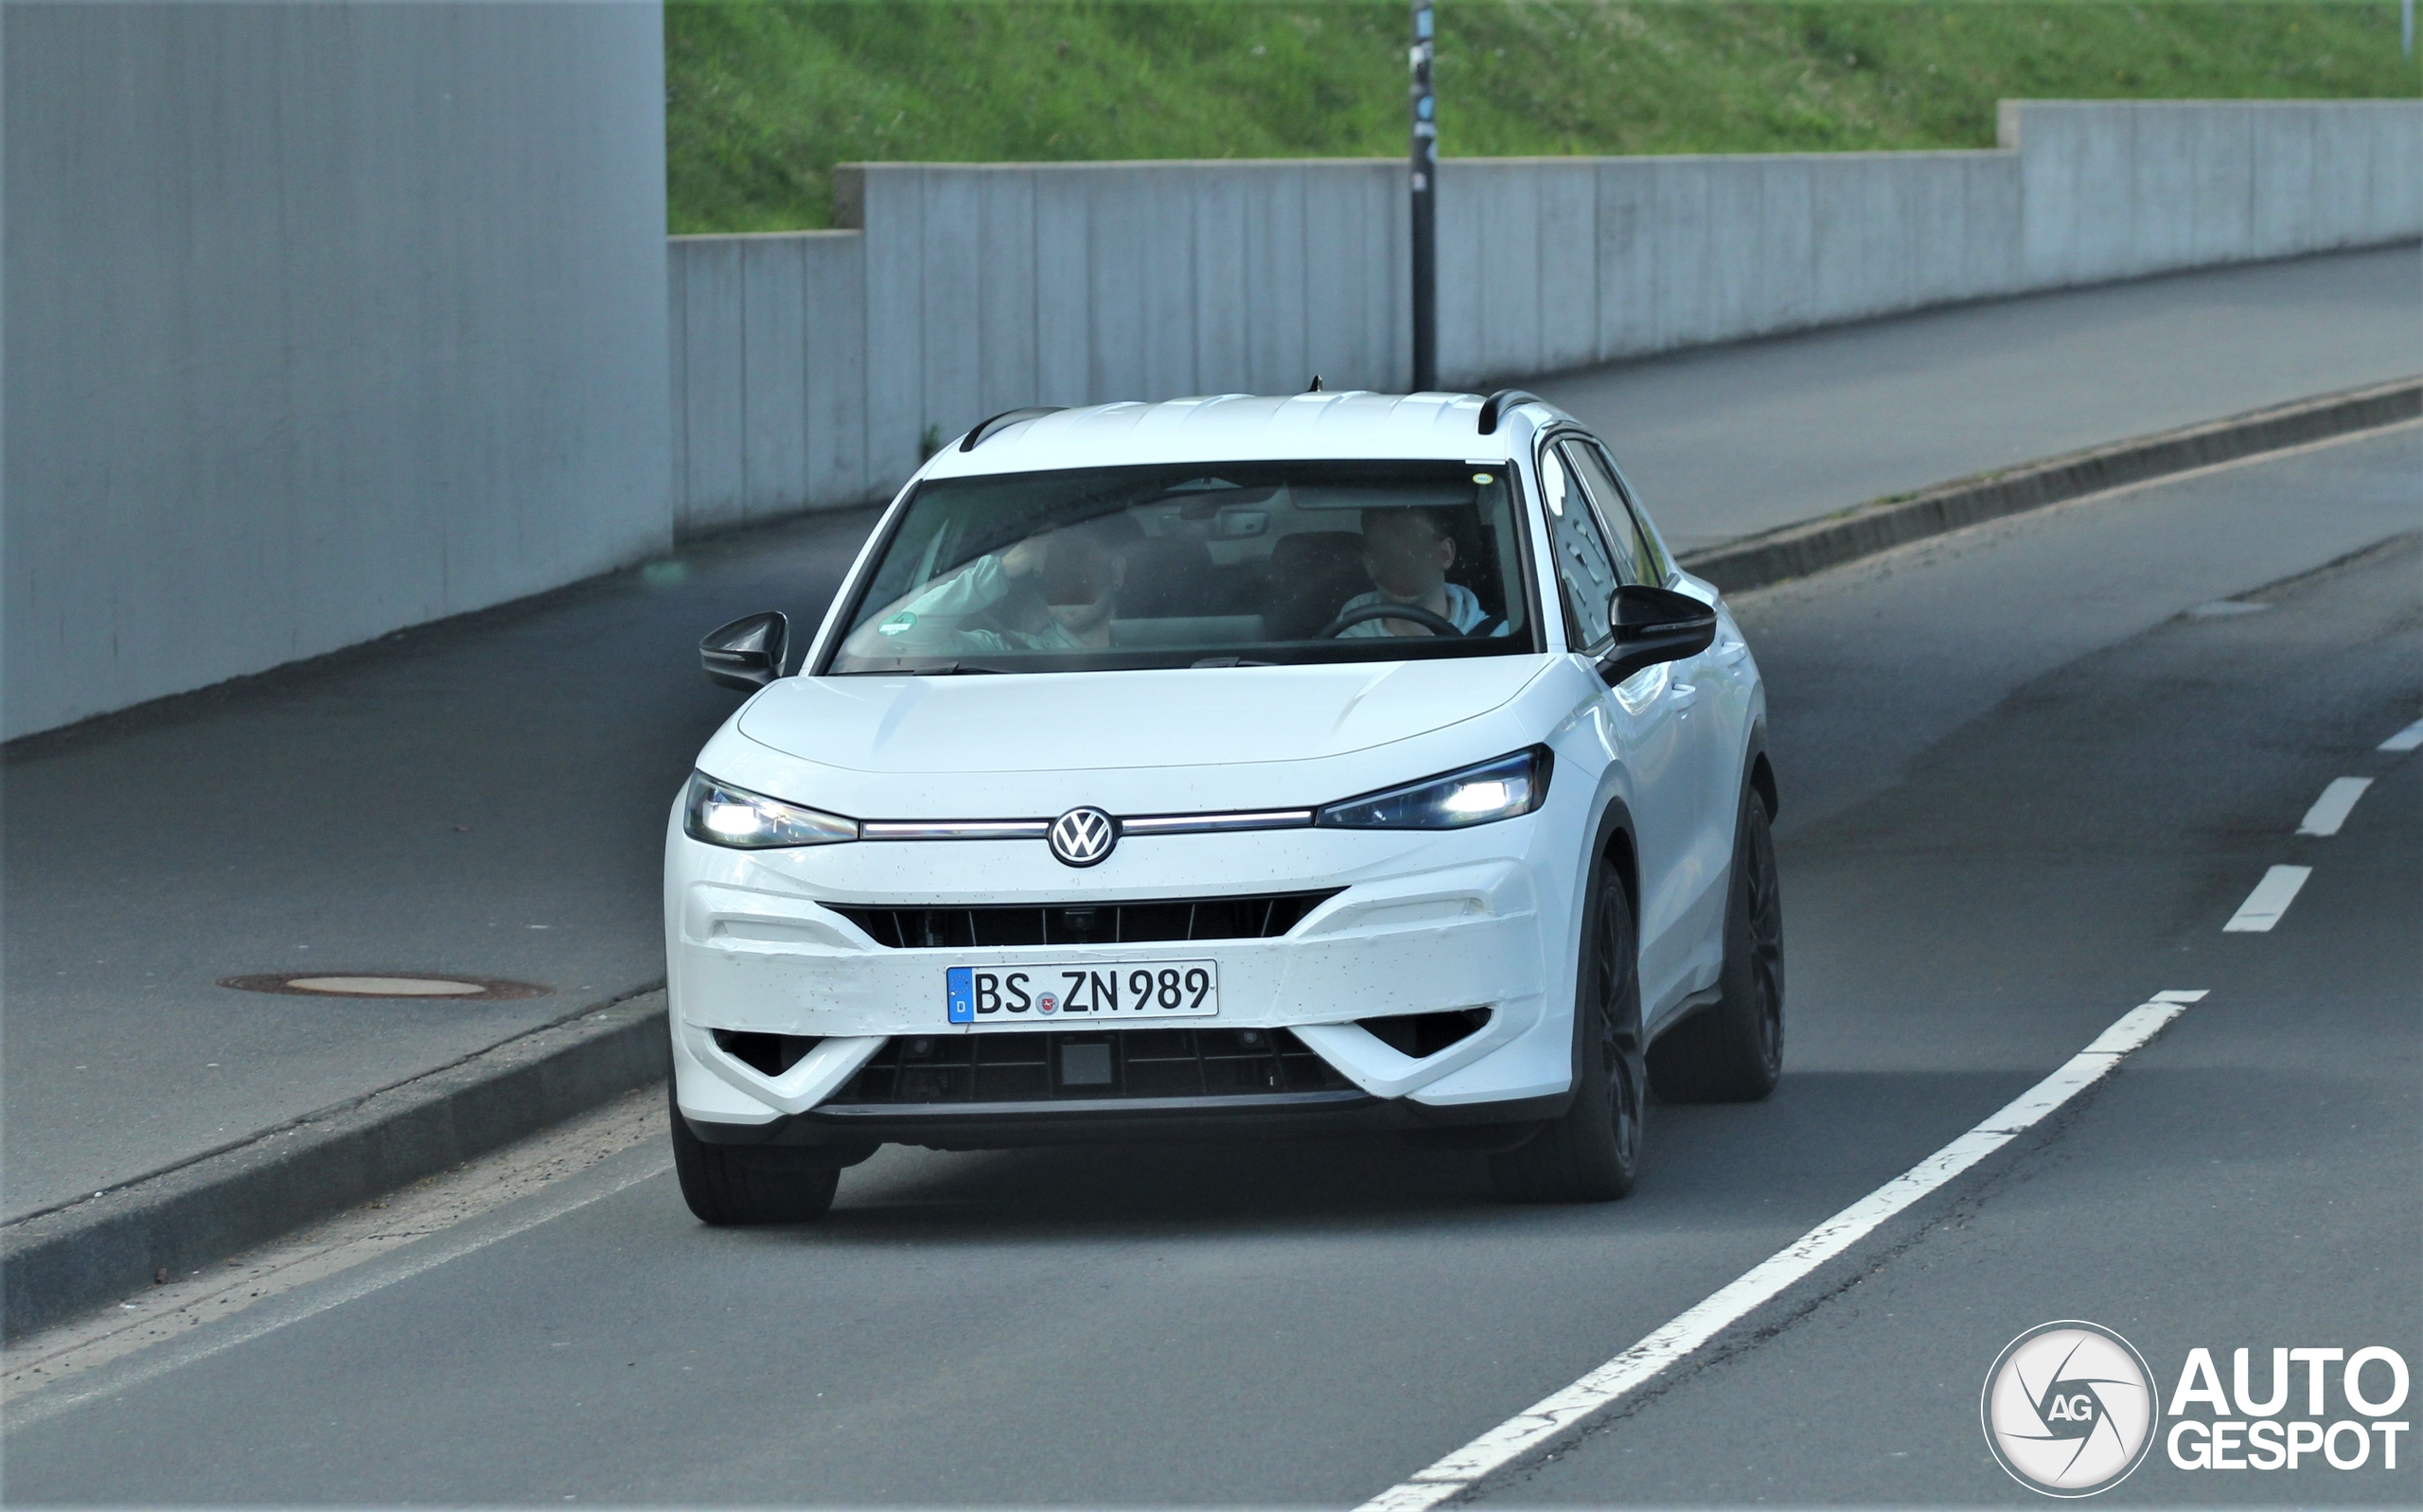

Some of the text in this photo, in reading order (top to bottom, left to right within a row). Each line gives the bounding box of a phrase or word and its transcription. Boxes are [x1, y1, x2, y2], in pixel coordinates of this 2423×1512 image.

[1053, 809, 1111, 861] VW
[957, 1001, 965, 1012] D
[975, 968, 1210, 1014] BS ZN 989
